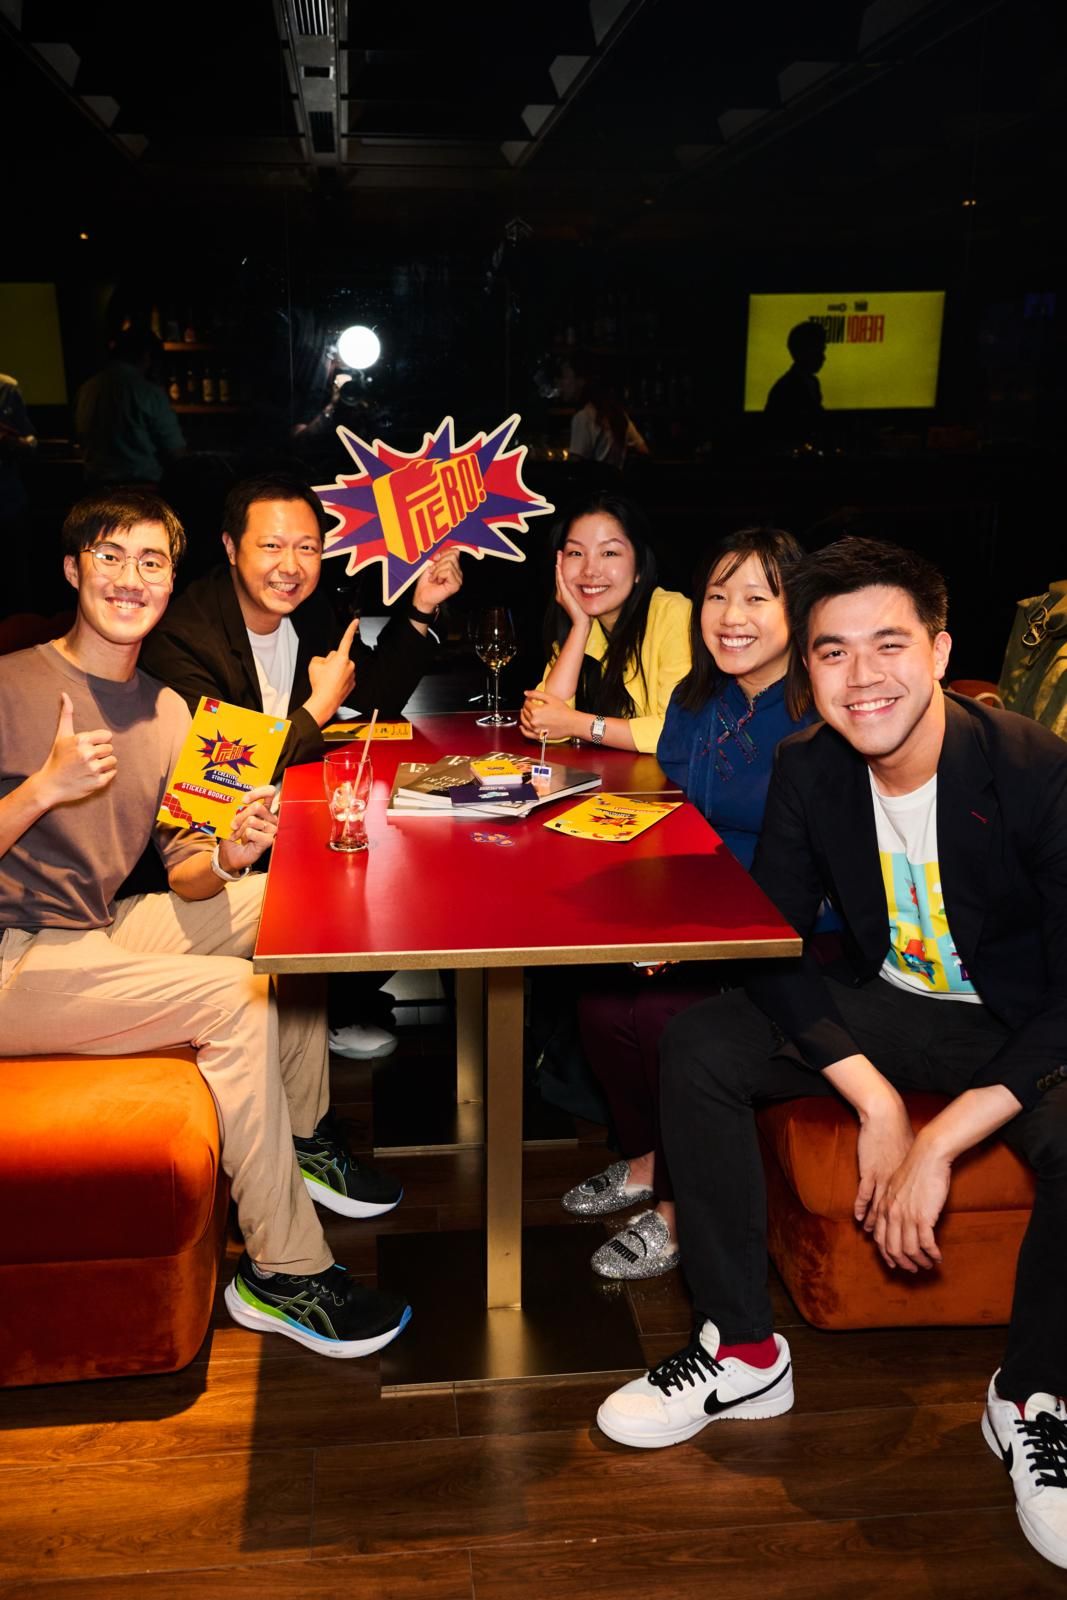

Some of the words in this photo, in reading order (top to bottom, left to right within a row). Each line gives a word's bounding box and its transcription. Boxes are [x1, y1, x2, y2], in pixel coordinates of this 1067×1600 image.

[388, 453, 487, 564] FIERO!
[181, 782, 206, 794] STICKER
[207, 789, 234, 802] BOOKLET
